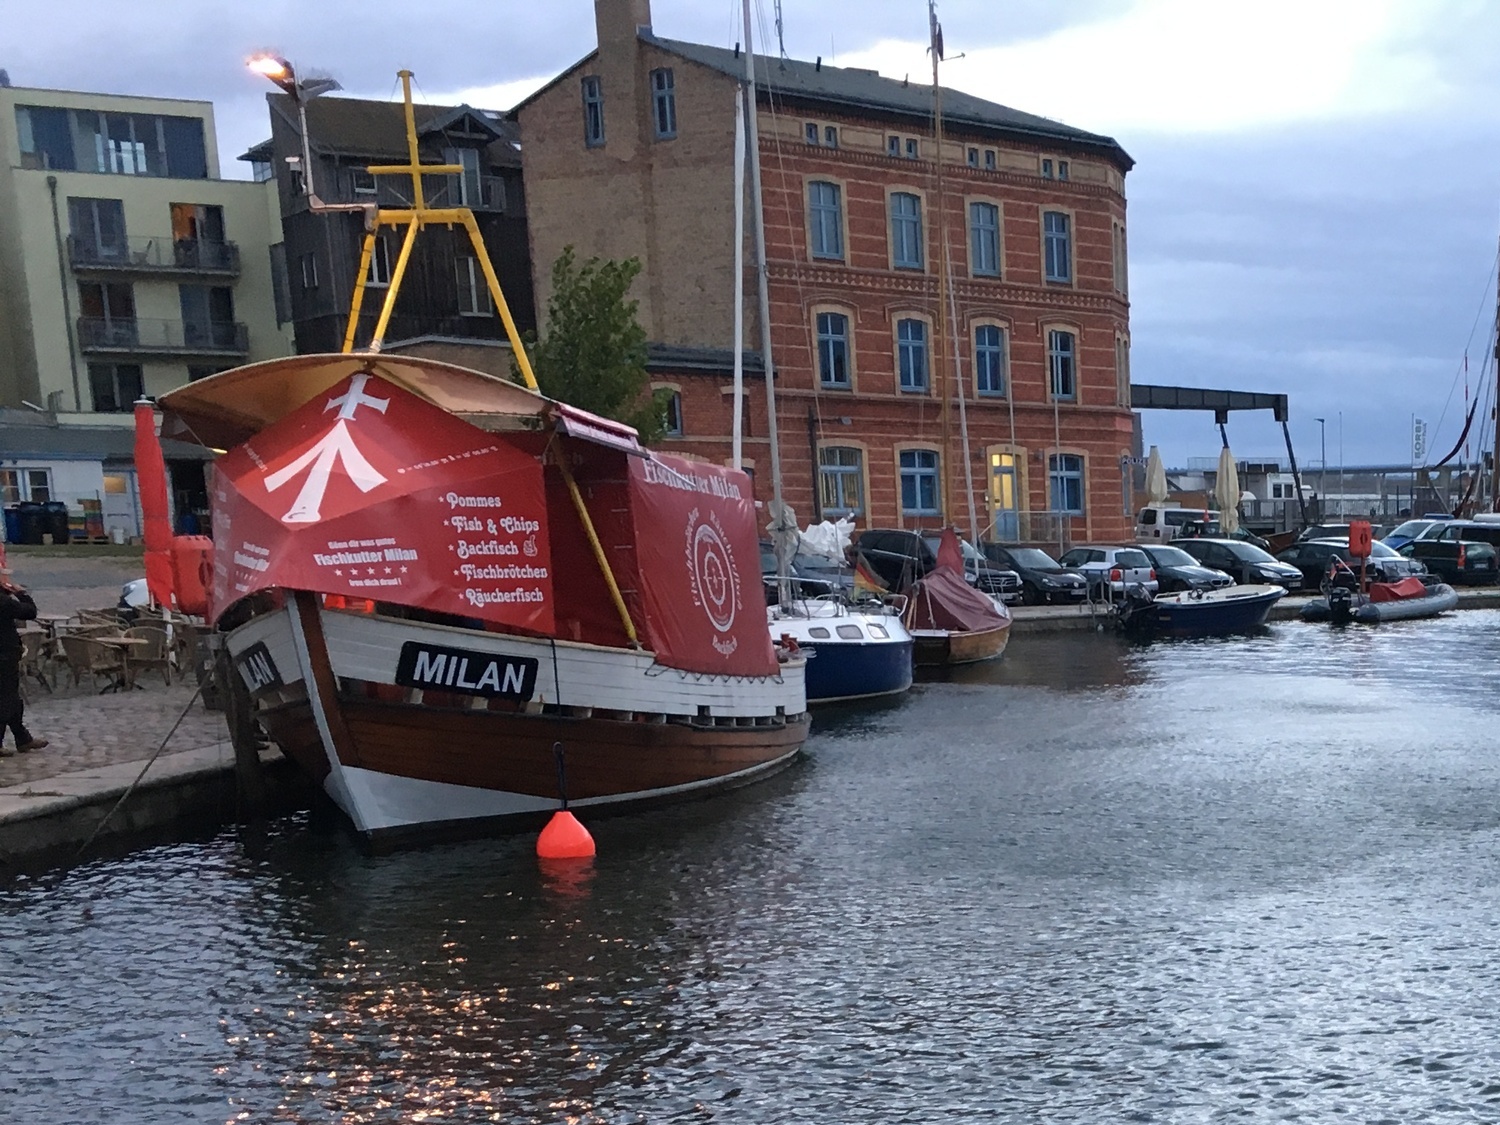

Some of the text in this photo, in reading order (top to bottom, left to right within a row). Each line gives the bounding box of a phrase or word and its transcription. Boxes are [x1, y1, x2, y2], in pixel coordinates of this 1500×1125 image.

[709, 474, 742, 501] Milan
[446, 492, 502, 510] Pommes
[451, 516, 540, 536] Fish & Chips
[313, 548, 418, 567] Fischkutter Milan
[457, 540, 519, 559] Backfisch
[460, 564, 548, 582] Fischbrötchen
[465, 586, 544, 607] Räucherfisch
[413, 650, 526, 694] MILAN
